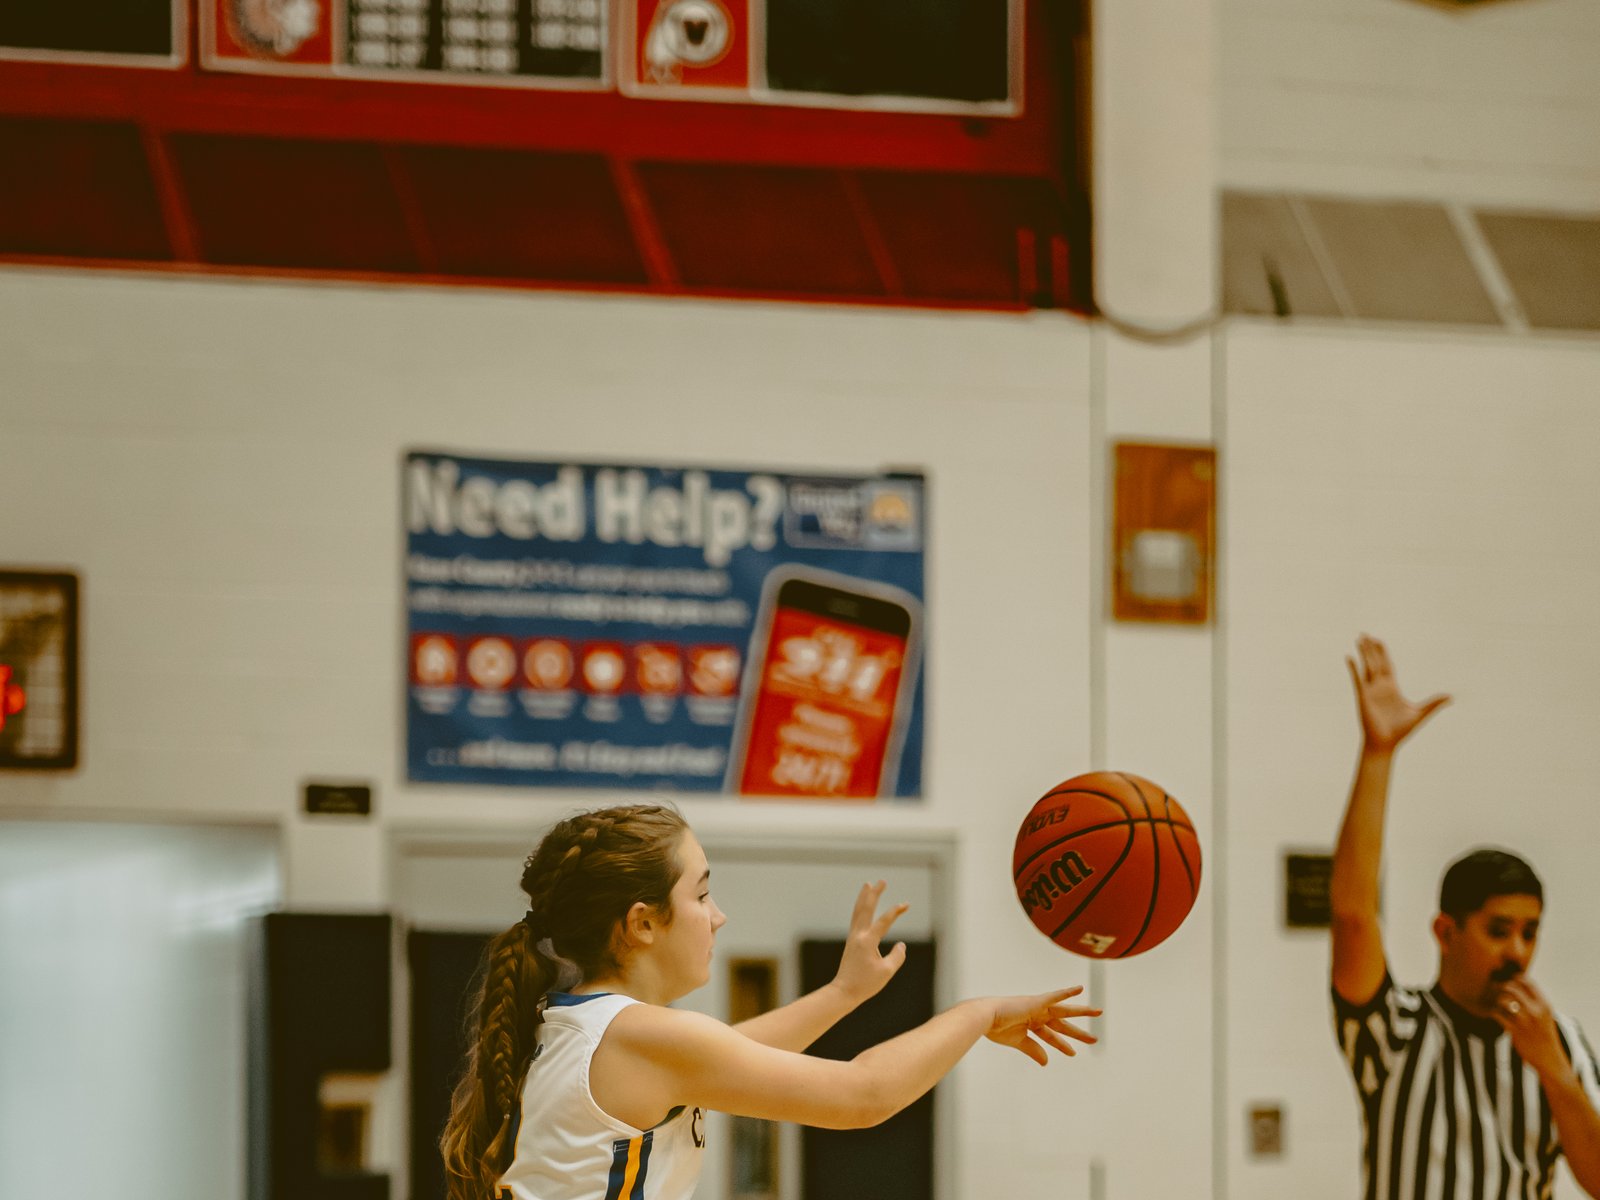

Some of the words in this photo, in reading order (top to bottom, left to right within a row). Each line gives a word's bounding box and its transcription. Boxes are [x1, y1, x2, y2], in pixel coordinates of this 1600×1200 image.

[408, 459, 586, 543] Need
[595, 467, 784, 568] Help?
[691, 1106, 705, 1148] C
